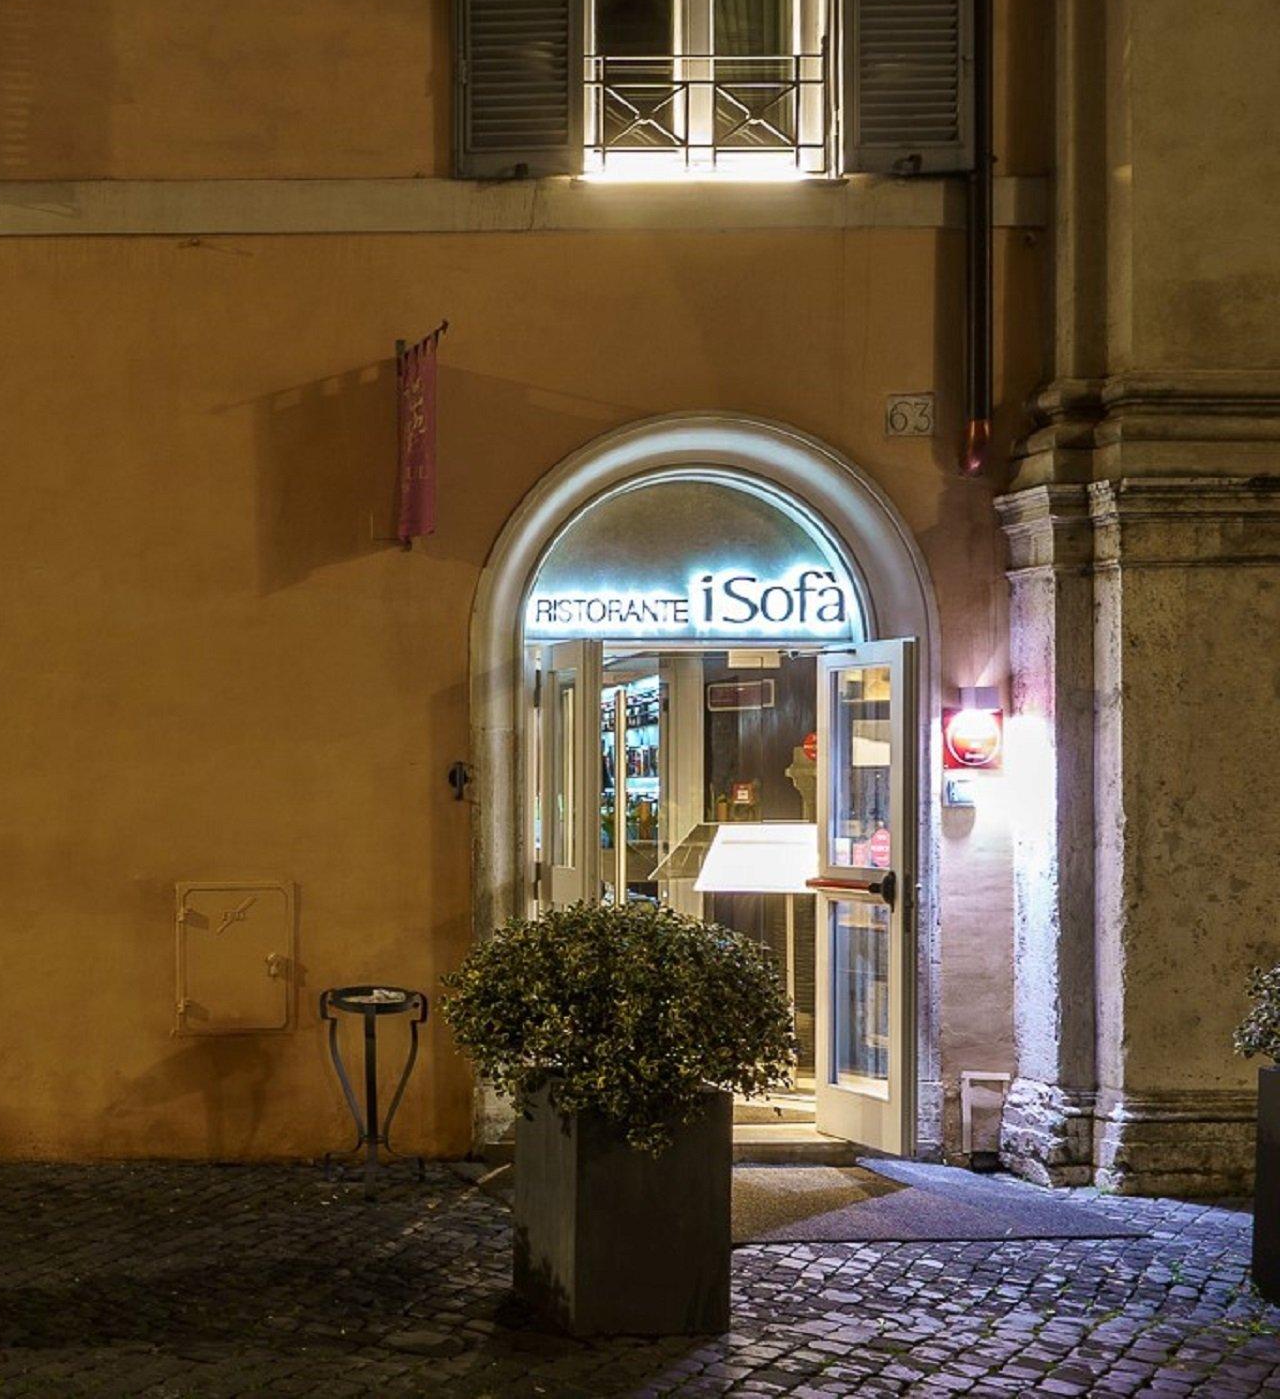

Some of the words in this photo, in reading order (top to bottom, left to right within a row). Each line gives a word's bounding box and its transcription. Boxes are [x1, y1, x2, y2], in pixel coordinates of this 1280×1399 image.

[889, 400, 931, 433] 63
[535, 598, 690, 624] RISTORANTE
[701, 570, 846, 624] iSofà
